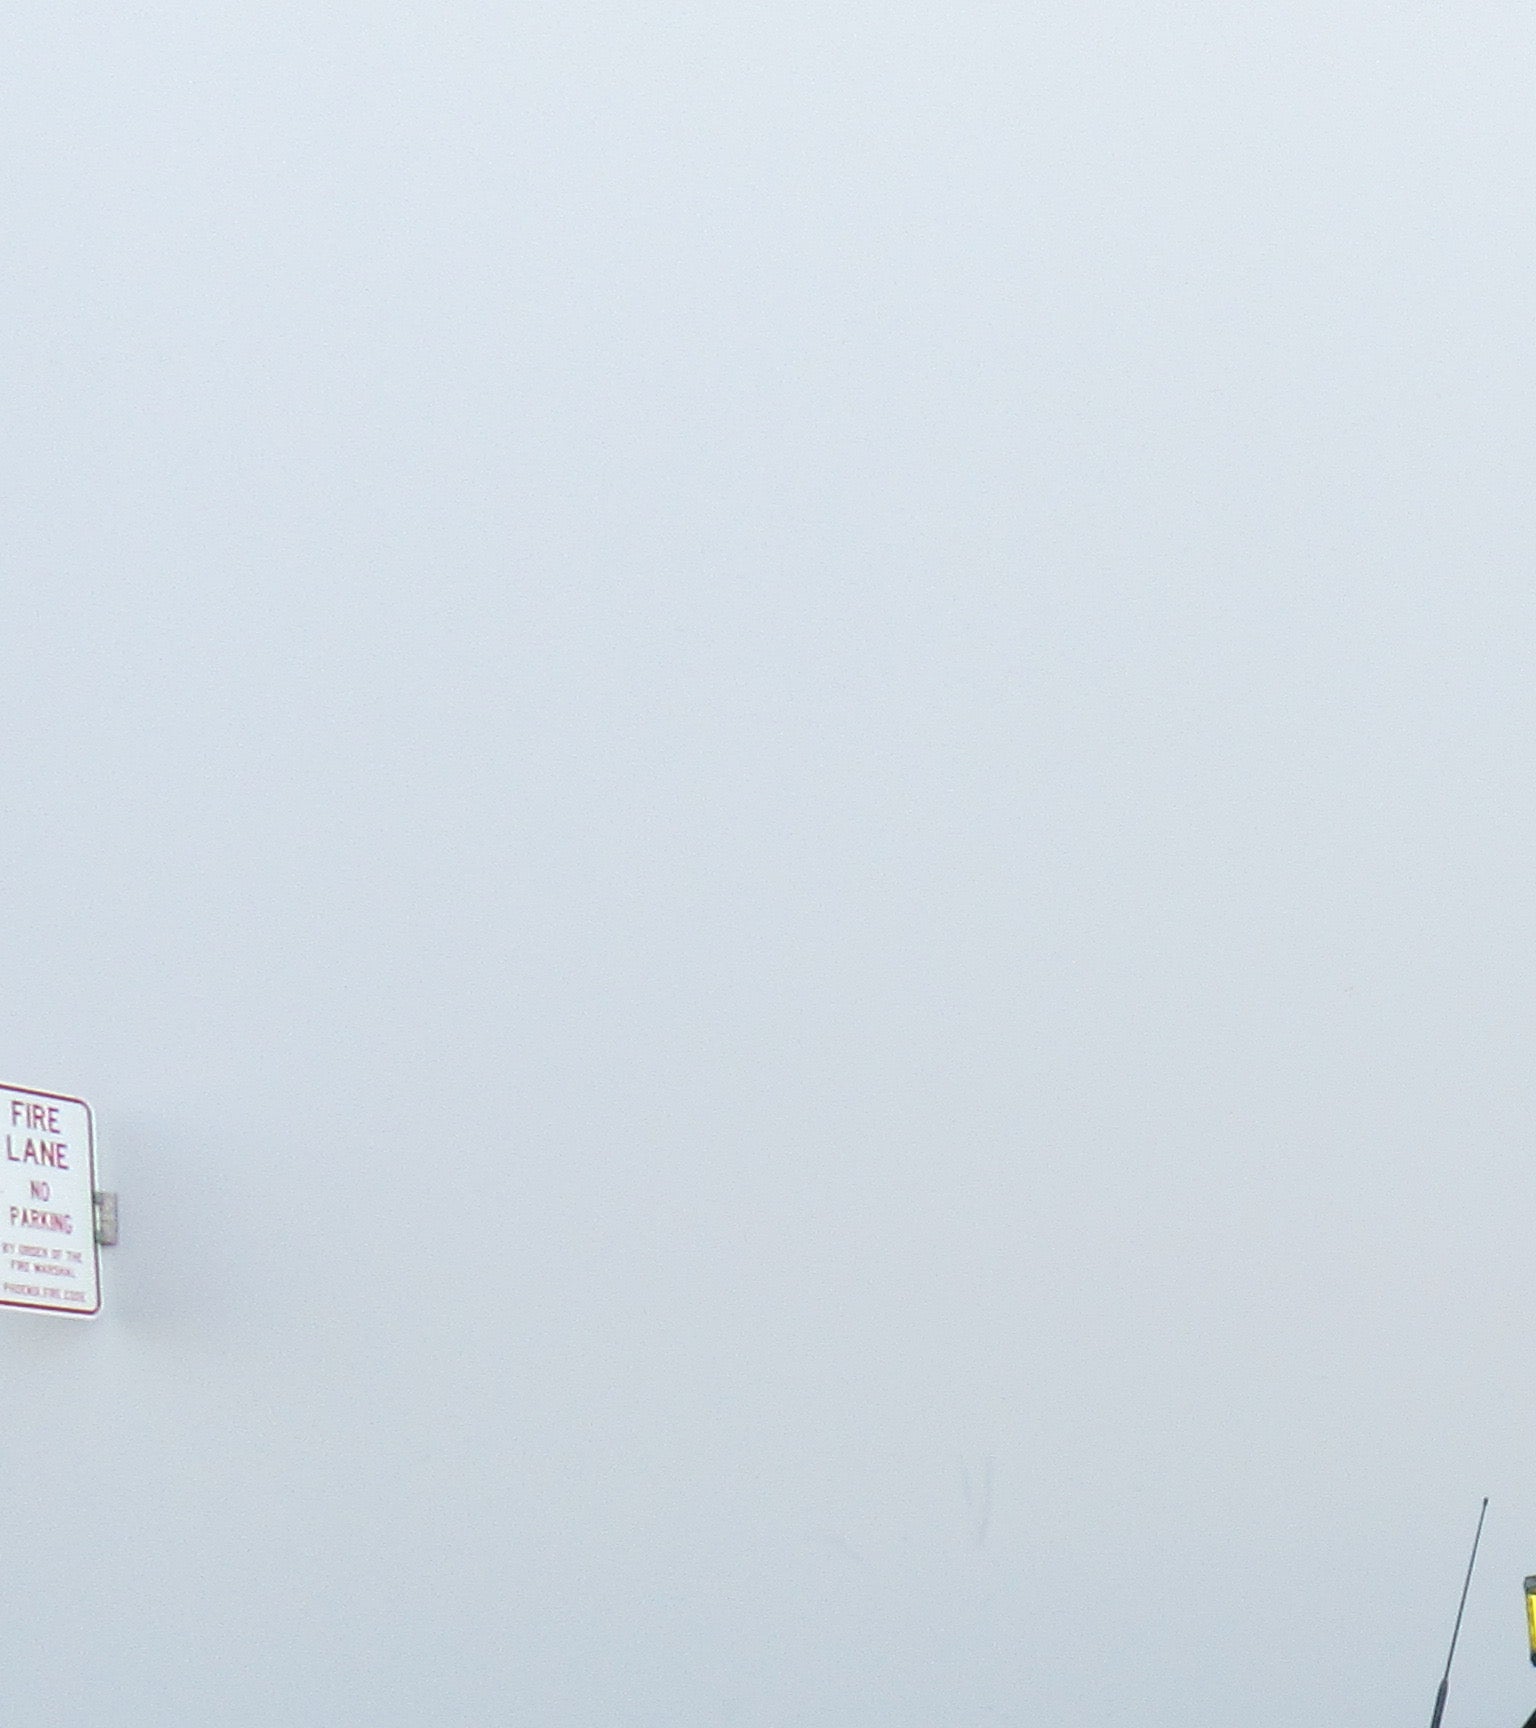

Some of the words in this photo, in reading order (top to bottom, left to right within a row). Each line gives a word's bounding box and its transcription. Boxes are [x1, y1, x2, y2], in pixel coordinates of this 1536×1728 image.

[10, 1101, 61, 1134] FIRE
[7, 1134, 69, 1169] LANE
[30, 1180, 51, 1201] NO
[10, 1206, 73, 1234] PARKING
